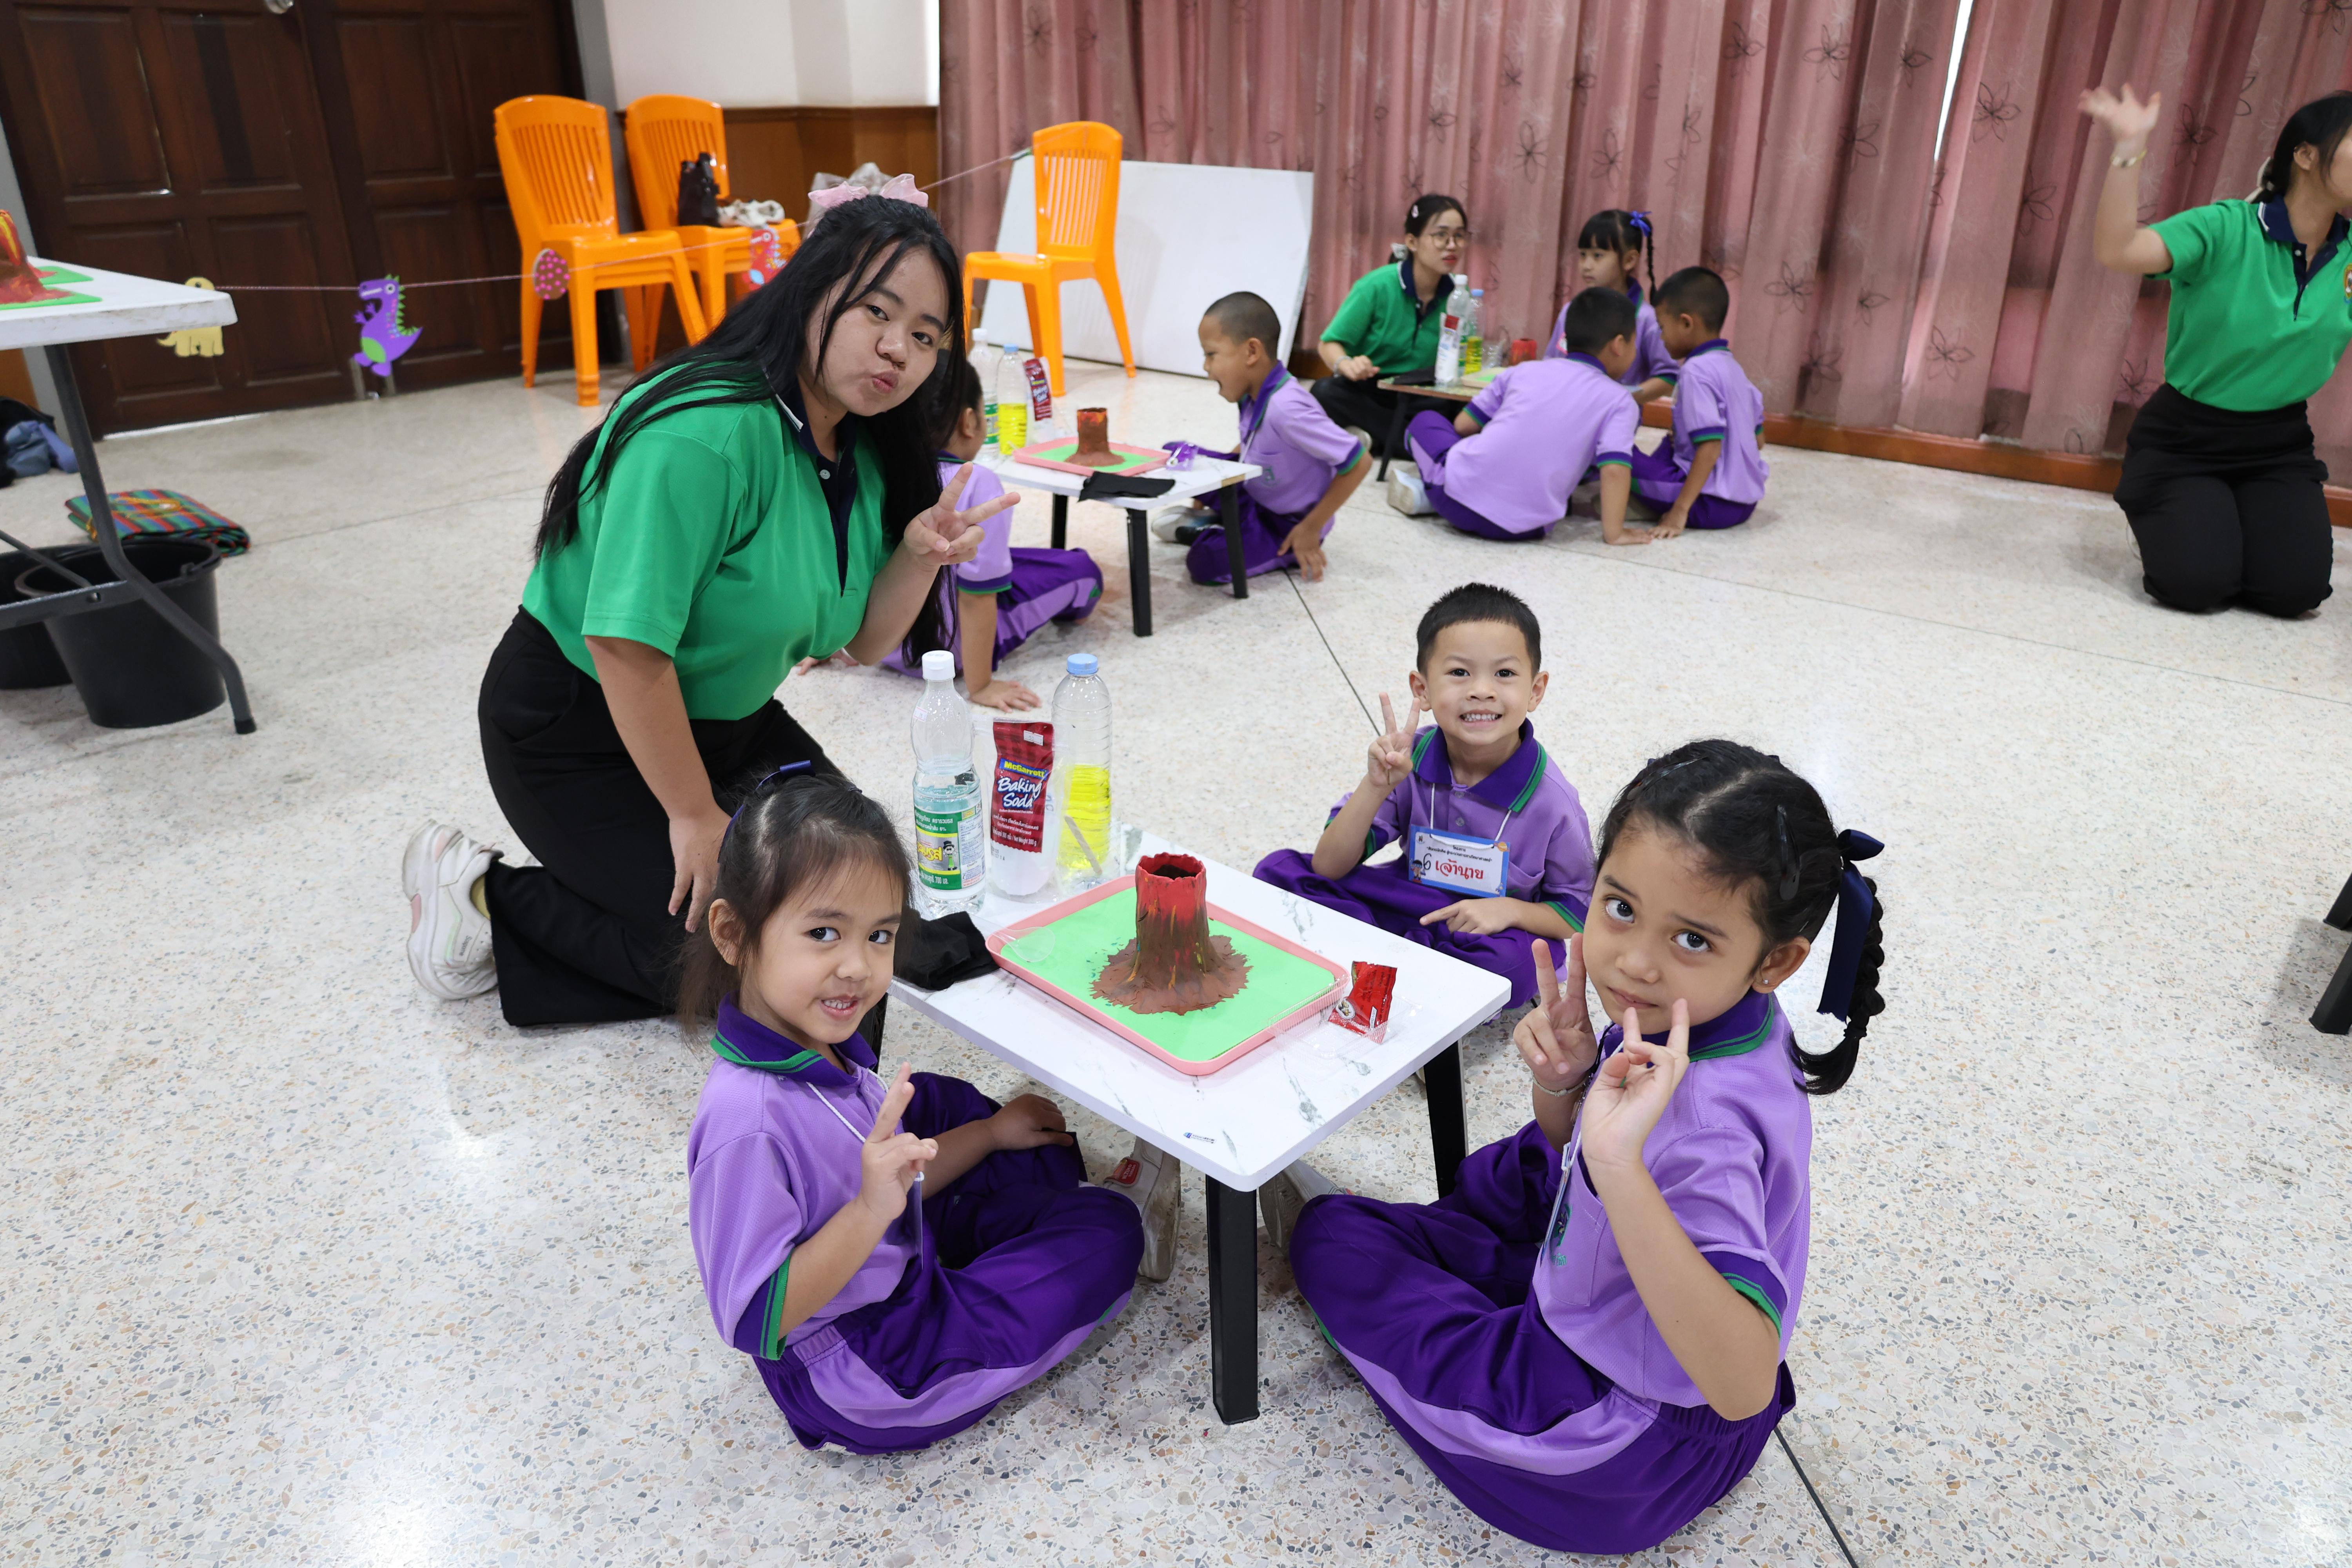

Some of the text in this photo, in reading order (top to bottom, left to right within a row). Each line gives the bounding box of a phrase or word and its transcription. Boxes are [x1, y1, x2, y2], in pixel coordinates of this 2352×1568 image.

[1004, 760, 1045, 777] McGarrett
[997, 777, 1042, 798] Baking
[1003, 793, 1033, 807] Soda
[1436, 859, 1484, 880] เจ้านาย
